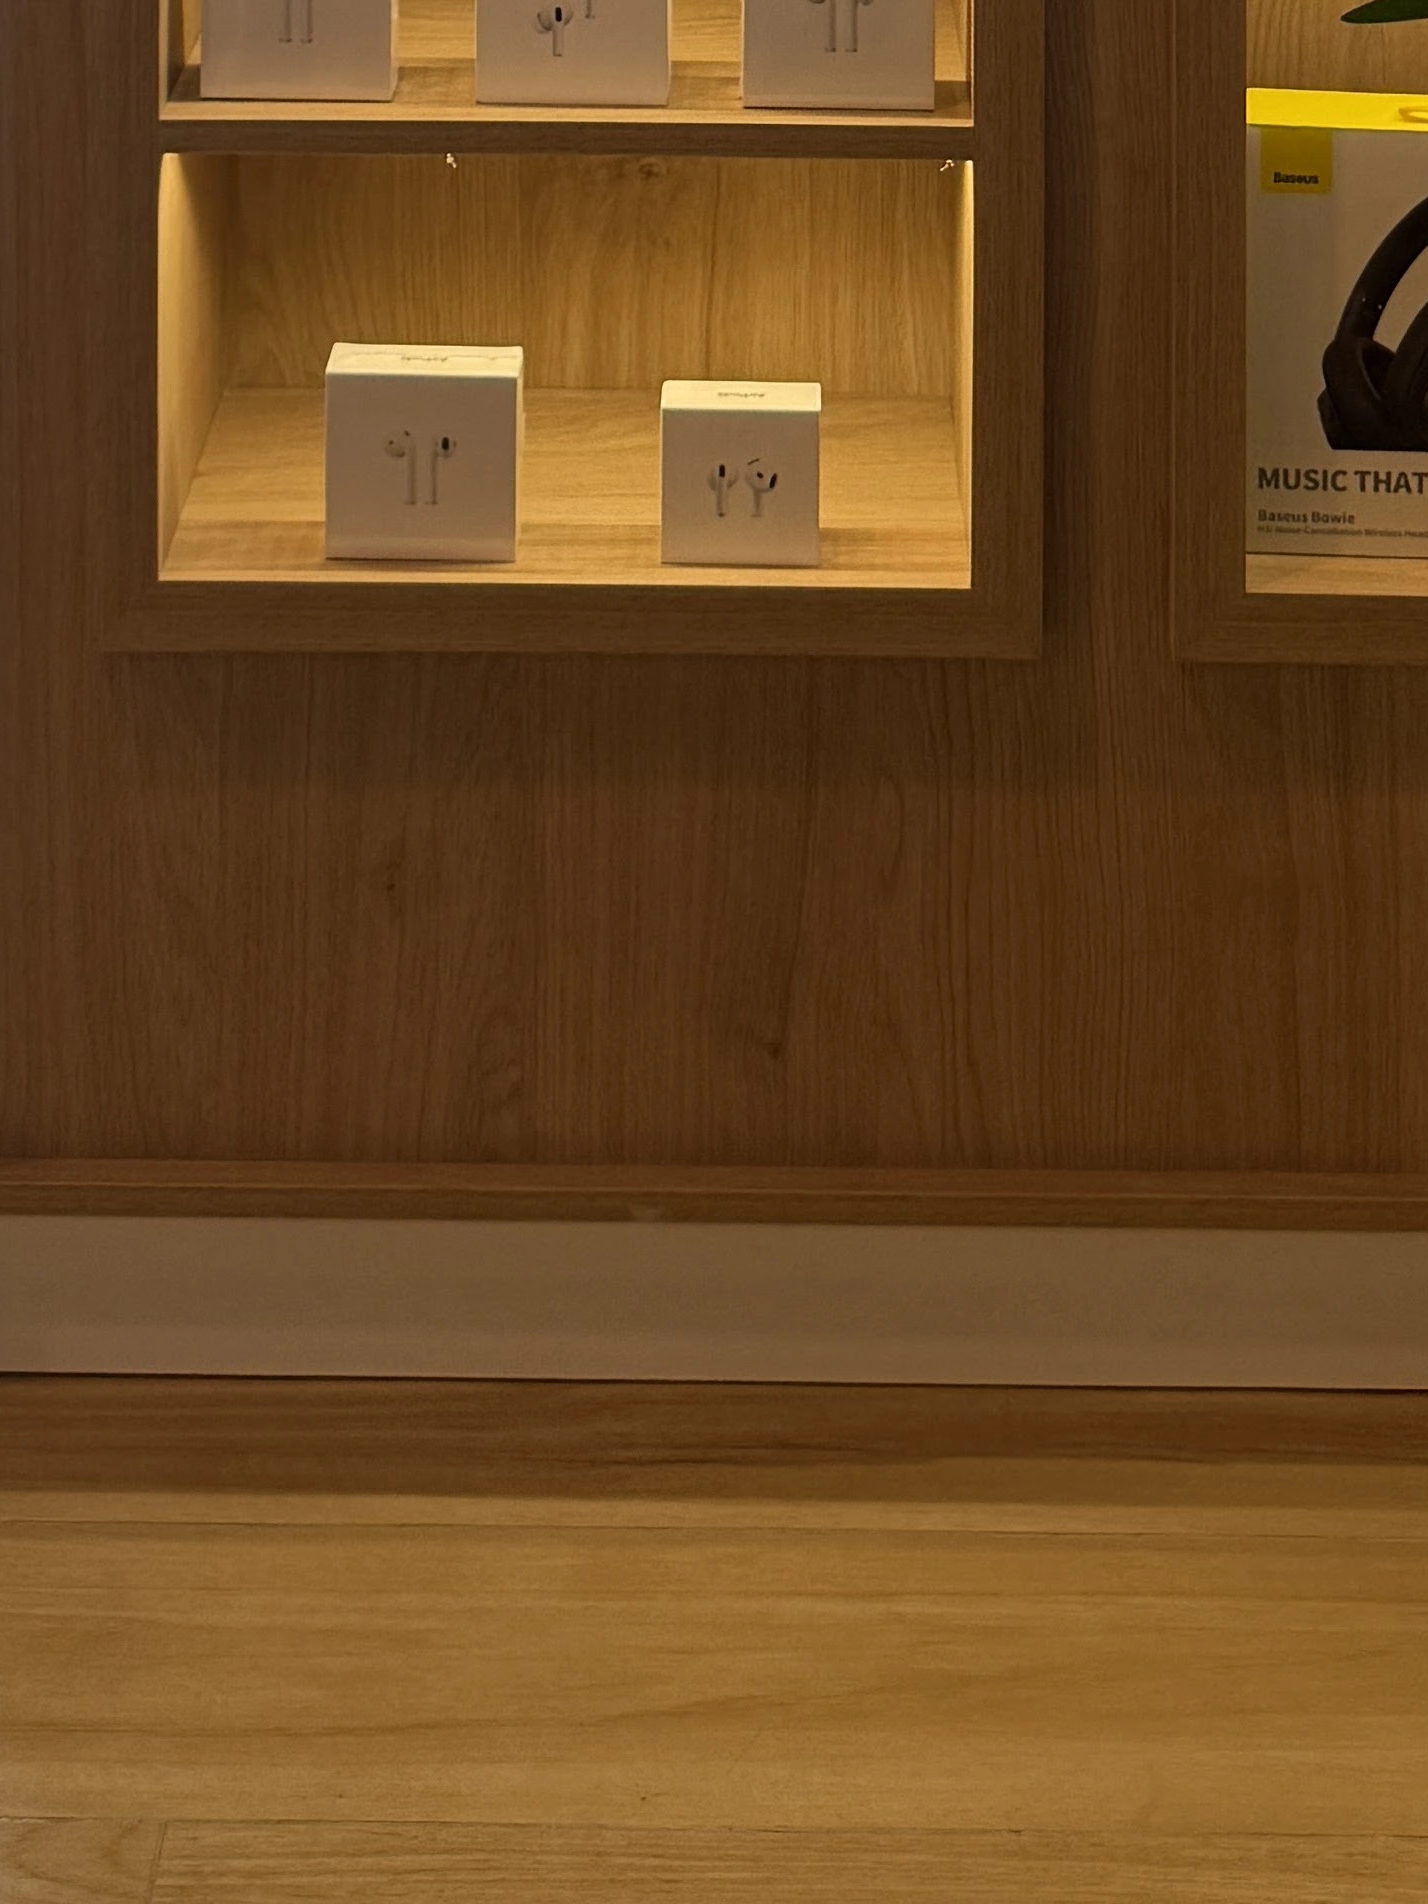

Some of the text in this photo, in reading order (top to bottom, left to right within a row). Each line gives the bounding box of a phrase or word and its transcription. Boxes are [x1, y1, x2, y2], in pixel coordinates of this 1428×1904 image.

[1273, 171, 1319, 184] Baseus
[1257, 468, 1347, 493] MUSIC
[1354, 470, 1428, 495] THAT
[1258, 509, 1355, 525] Baseus Bowie
